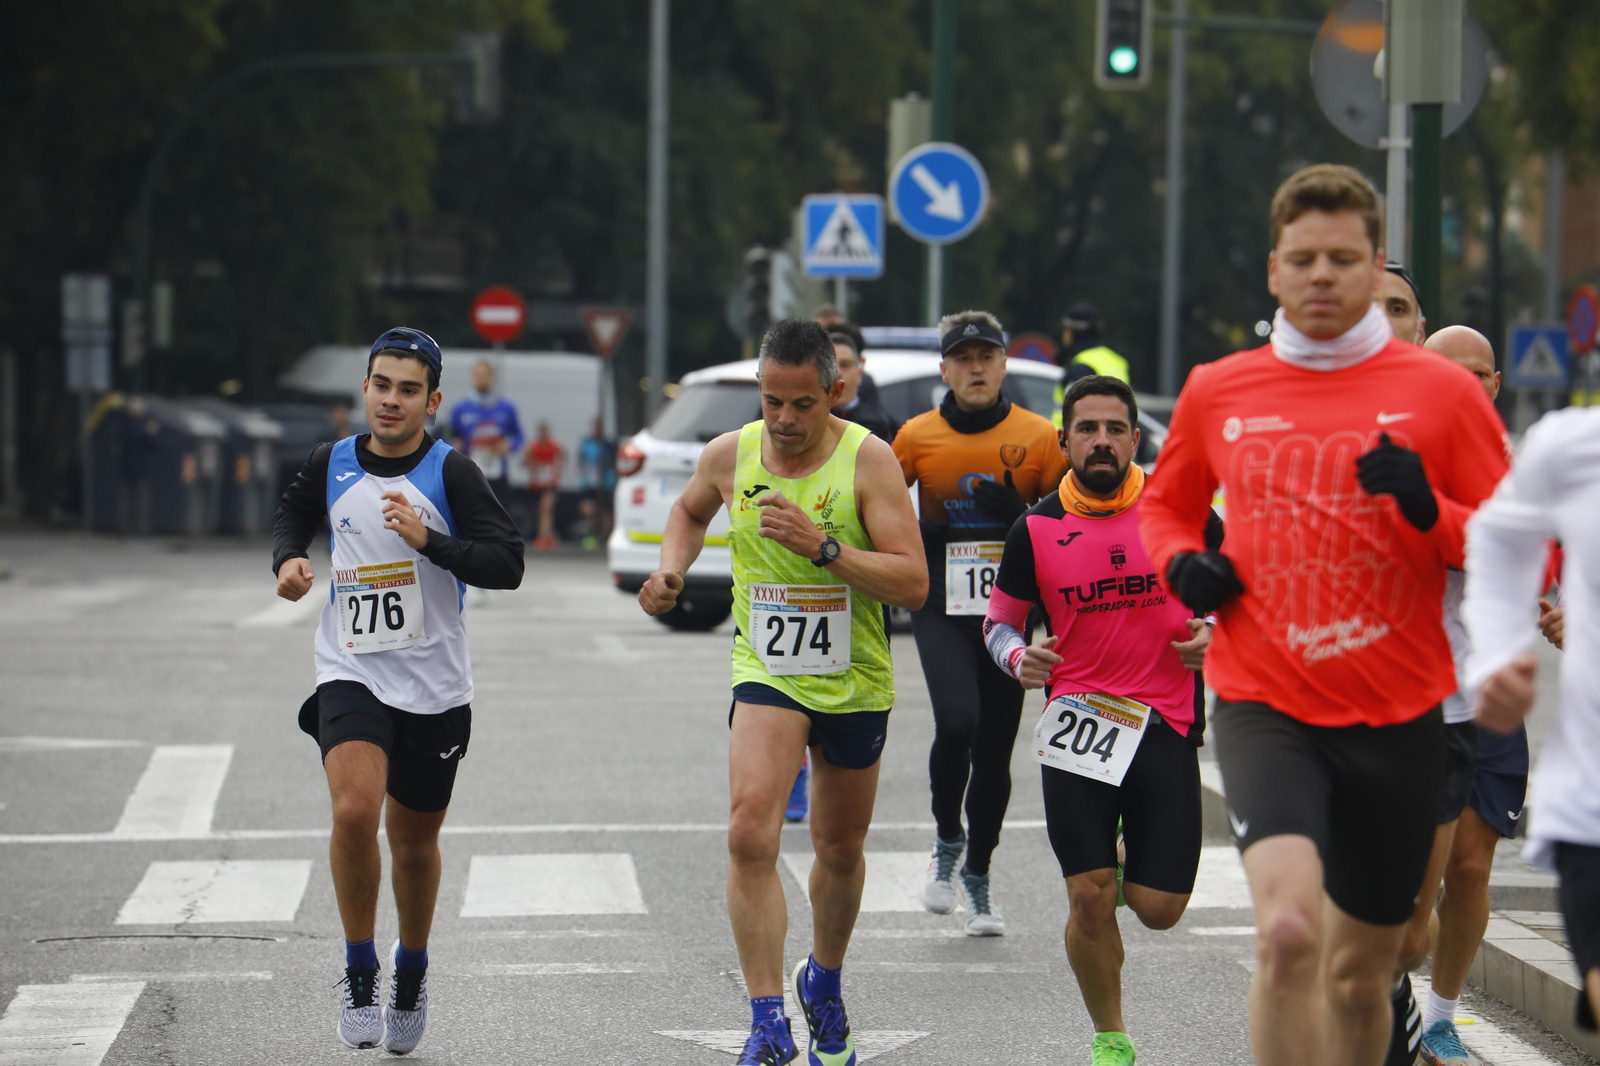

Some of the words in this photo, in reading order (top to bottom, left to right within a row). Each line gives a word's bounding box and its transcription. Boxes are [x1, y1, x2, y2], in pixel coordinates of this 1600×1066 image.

[943, 499, 976, 510] COME
[949, 545, 979, 558] XXXIX
[335, 568, 358, 584] XXXIX
[373, 578, 416, 589] TRINITARIOS
[965, 566, 1000, 600] 18
[753, 586, 787, 603] XXXIX
[1058, 573, 1163, 605] TUFiBR
[802, 604, 847, 612] TRINITARIOS
[1141, 594, 1168, 608] LOCAL
[348, 591, 405, 635] 276
[766, 615, 832, 656] 274
[1077, 702, 1096, 713] Trinidad
[1111, 701, 1130, 712] TRINIDAD
[1099, 711, 1141, 730] TRINITARIOS
[1048, 710, 1121, 763] 204
